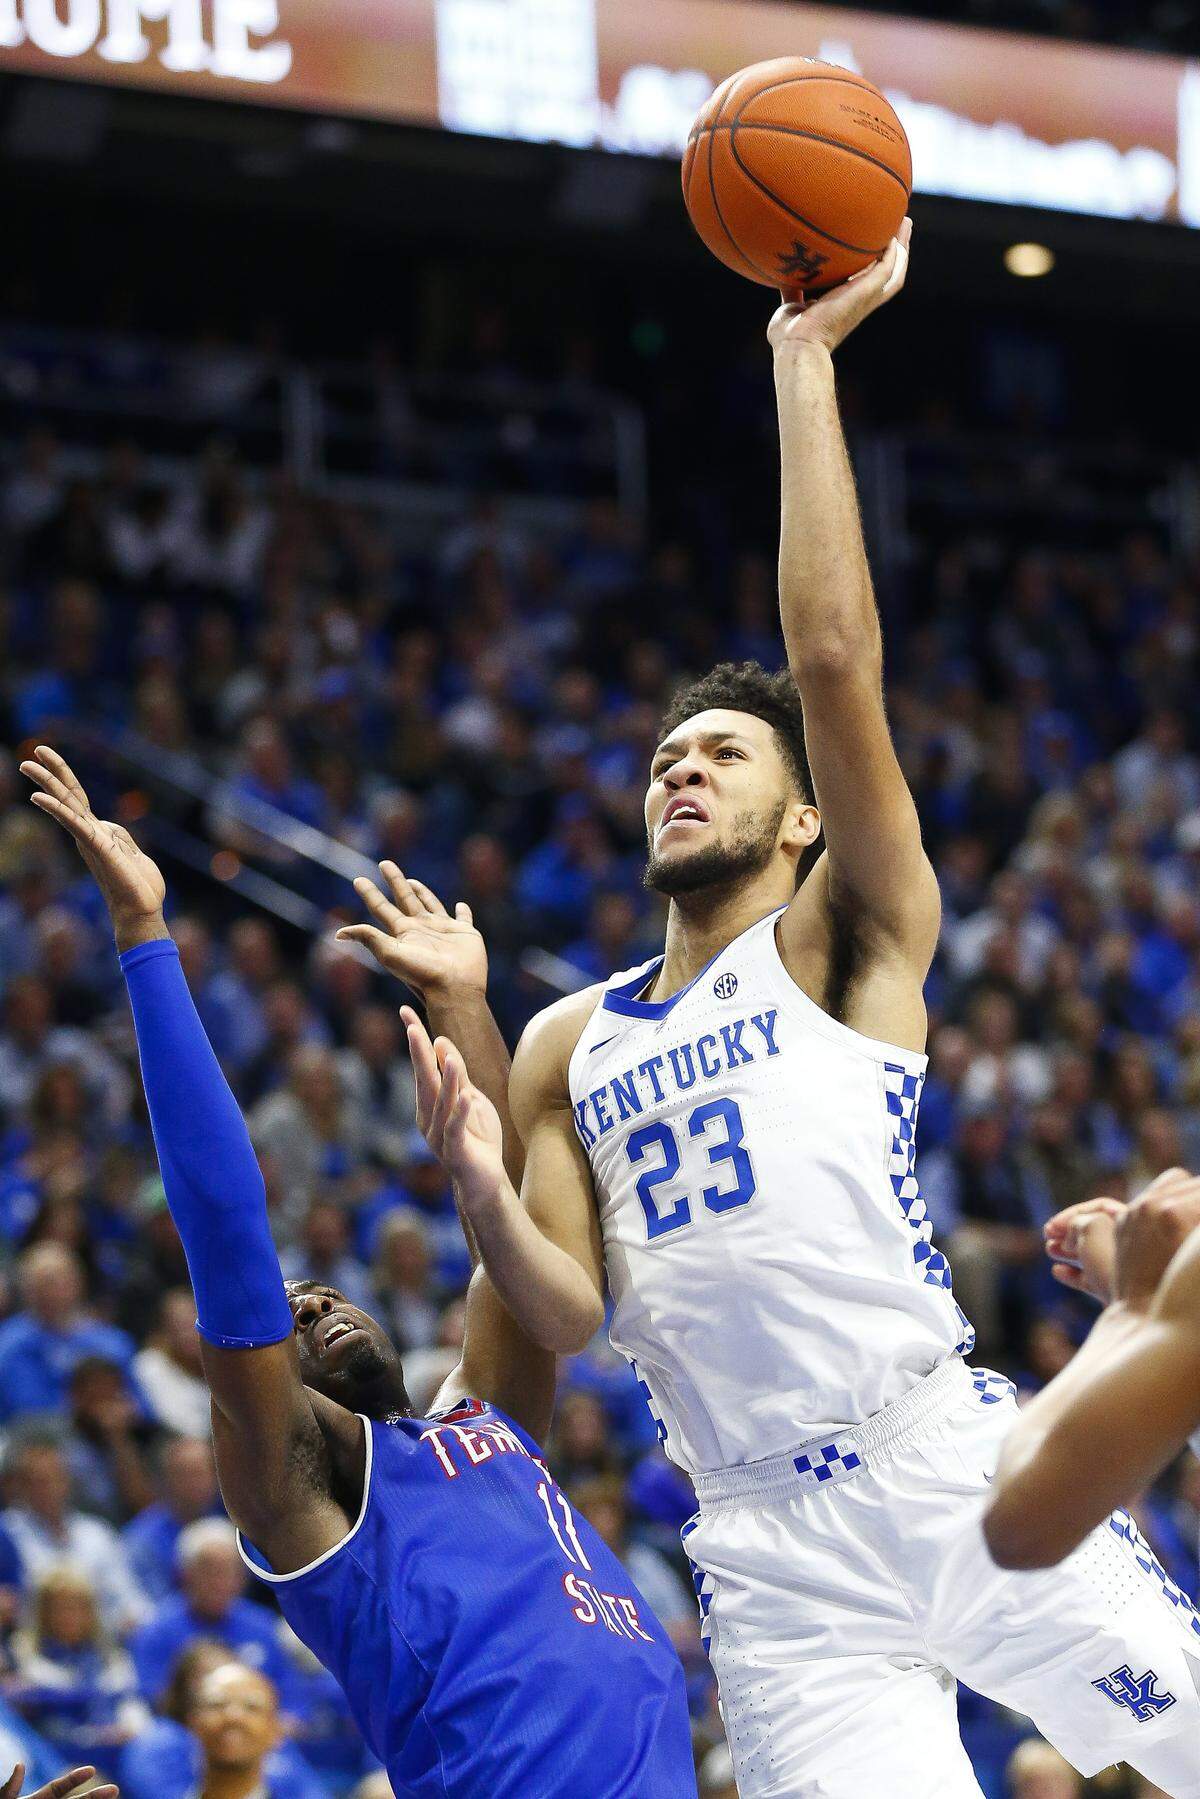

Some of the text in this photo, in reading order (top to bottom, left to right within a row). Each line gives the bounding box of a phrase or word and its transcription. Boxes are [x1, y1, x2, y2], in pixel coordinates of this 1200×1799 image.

[714, 973, 738, 999] SEC
[574, 1009, 780, 1151] KENTUCKY
[625, 1097, 758, 1243] 23
[537, 1481, 592, 1572] 11
[564, 1572, 656, 1643] STATE
